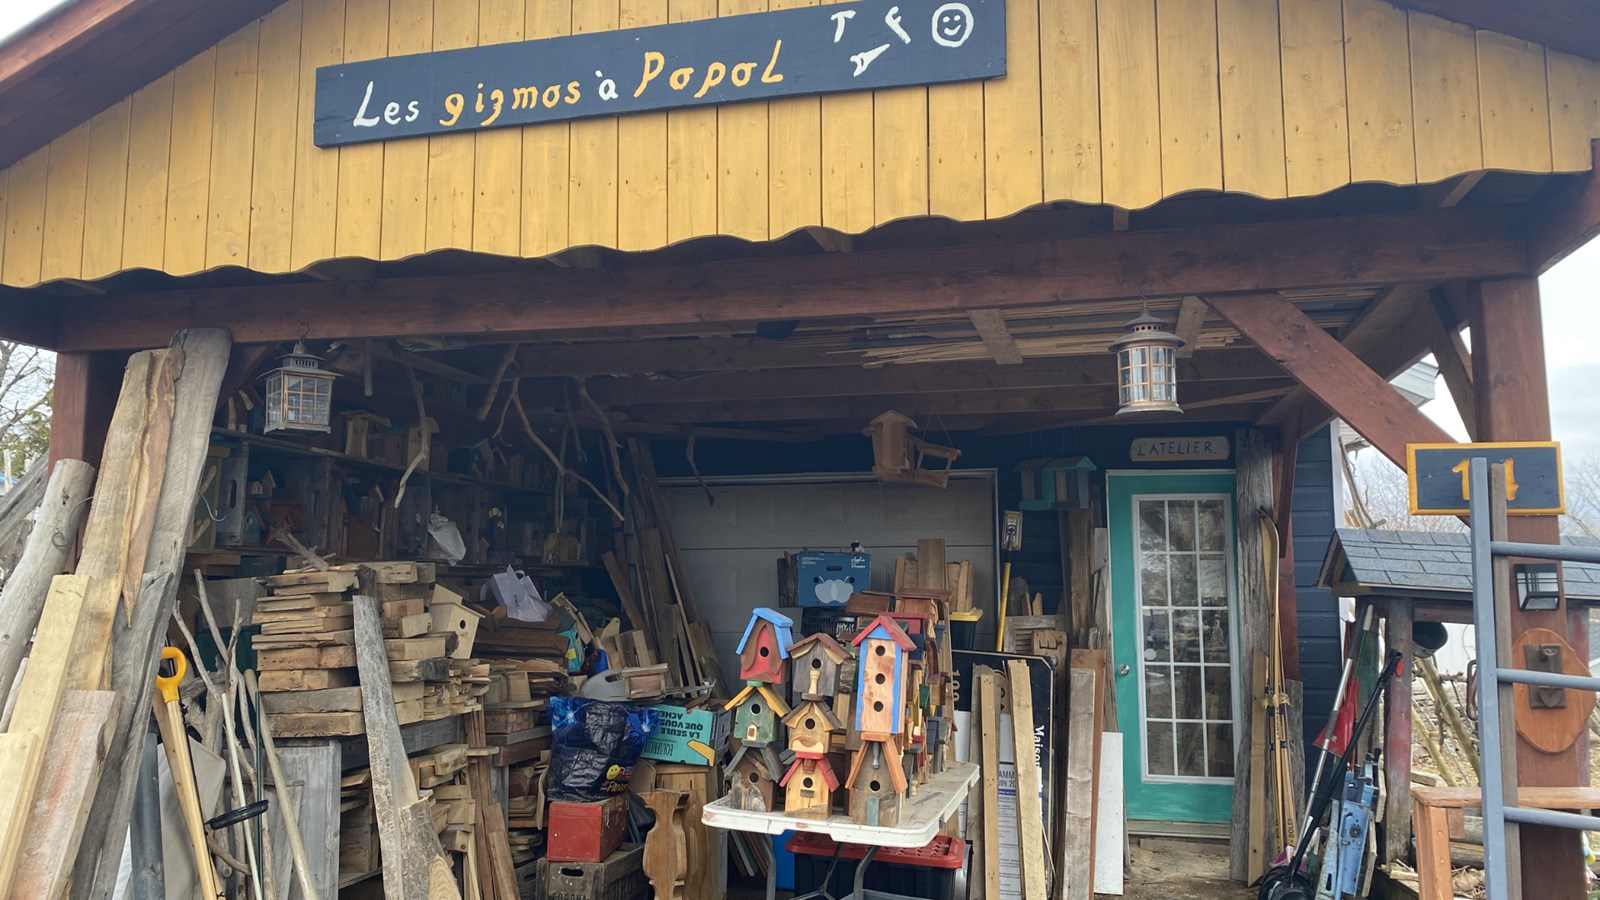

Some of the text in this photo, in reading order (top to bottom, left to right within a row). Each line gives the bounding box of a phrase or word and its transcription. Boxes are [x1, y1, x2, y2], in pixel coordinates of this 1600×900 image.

[353, 80, 420, 127] Les
[439, 80, 581, 127] gizmos
[594, 70, 619, 101] à
[659, 711, 684, 719] ACHE
[660, 719, 704, 731] QUE VOUS
[660, 727, 700, 739] LA SEULE
[998, 770, 1015, 779] AMM
